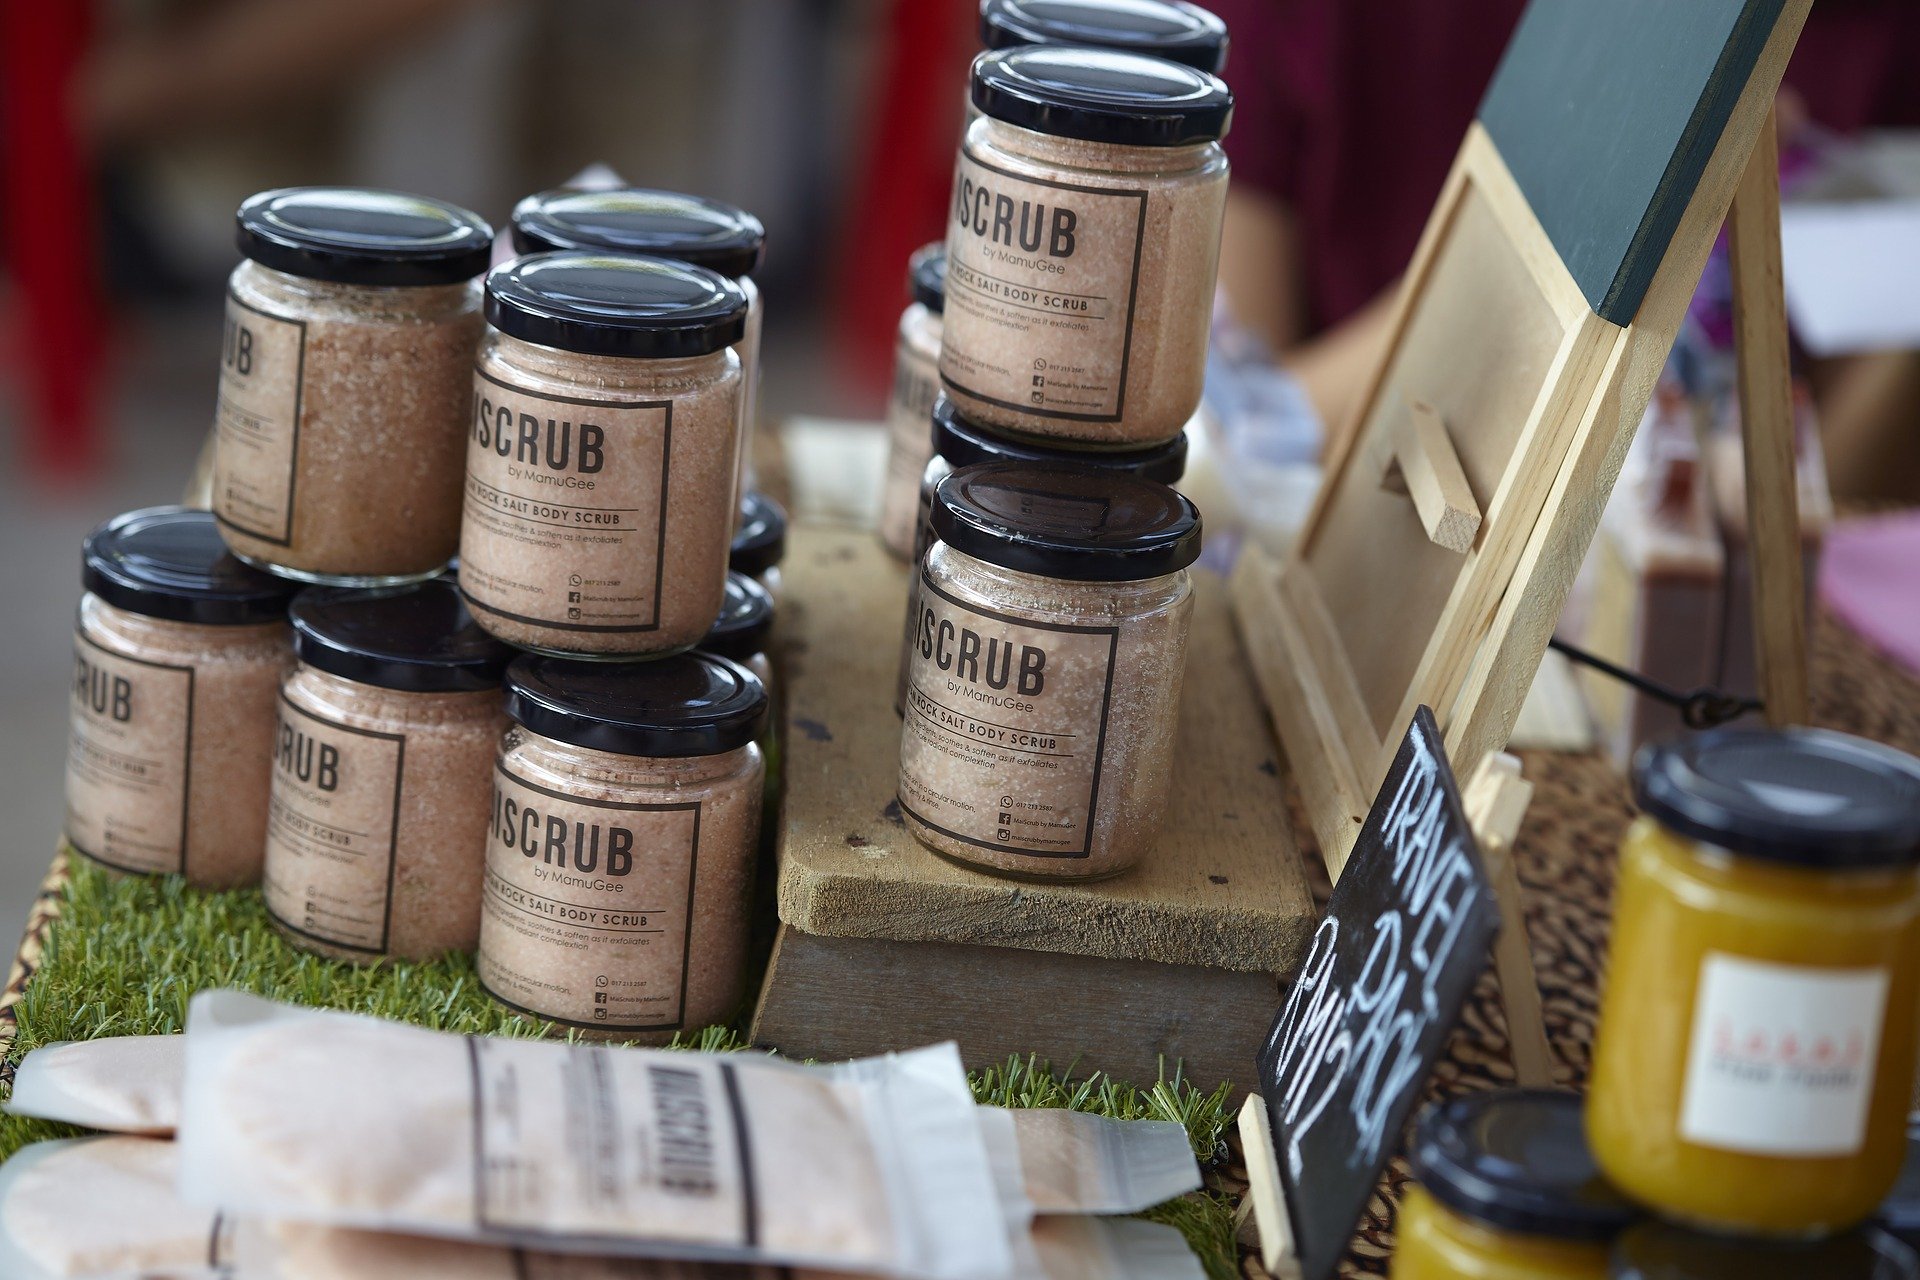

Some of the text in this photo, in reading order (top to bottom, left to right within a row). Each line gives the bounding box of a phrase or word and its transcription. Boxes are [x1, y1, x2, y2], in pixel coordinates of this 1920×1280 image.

[957, 172, 1077, 258] ISCRUB
[983, 244, 1066, 275] by MamuGee
[978, 278, 1000, 294] SALT
[1004, 287, 1038, 303] BODY
[1043, 296, 1088, 311] SCRUB
[224, 316, 253, 376] UB
[473, 392, 605, 473] ISCRUB
[508, 463, 595, 491] by MamuGee
[503, 497, 528, 513] SALT
[533, 506, 569, 520] BODY
[575, 512, 620, 525] SCRUB
[582, 534, 623, 544] exfoliates
[915, 600, 1046, 697] ISCRUB
[75, 655, 132, 722] RUB
[947, 679, 1034, 713] by MamuGee
[917, 696, 938, 718] ROCK
[941, 711, 965, 729] SALT
[969, 723, 1005, 740] BODY
[1011, 735, 1057, 749] SCRUB
[972, 747, 997, 760] soften
[998, 753, 1008, 762] as
[1009, 755, 1015, 764] it
[1017, 757, 1058, 769] exfoliates
[491, 787, 634, 876] ISCRUB
[534, 865, 624, 893] by MamuGee
[501, 884, 526, 905] ROCK
[529, 898, 555, 915] SALT
[560, 907, 597, 923] BODY
[602, 914, 648, 926] SCRUB
[564, 930, 589, 941] soften
[591, 933, 601, 943] as
[610, 936, 650, 946] exfoliates
